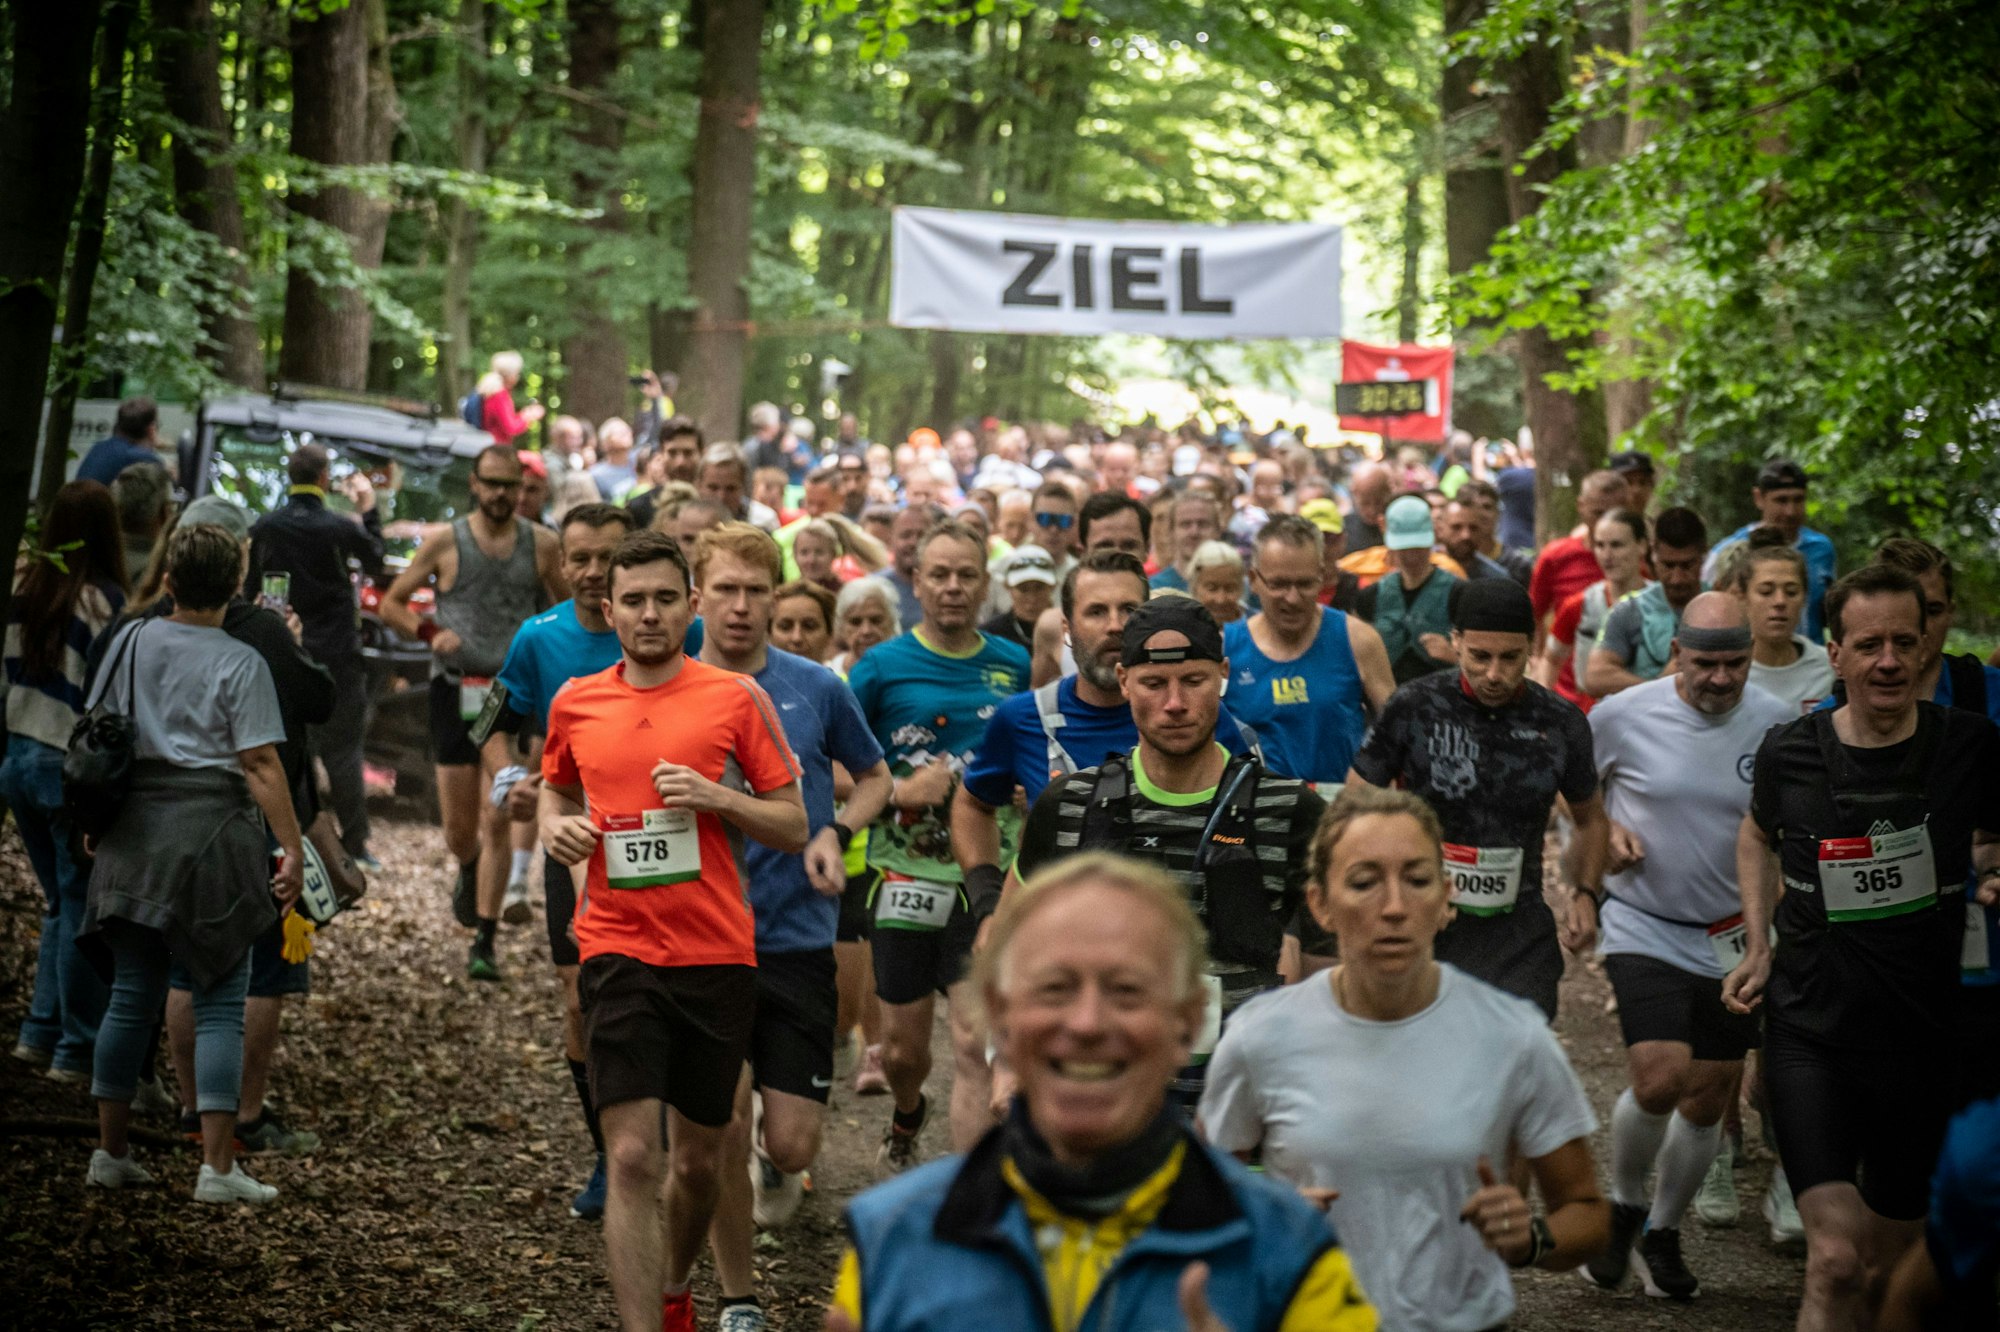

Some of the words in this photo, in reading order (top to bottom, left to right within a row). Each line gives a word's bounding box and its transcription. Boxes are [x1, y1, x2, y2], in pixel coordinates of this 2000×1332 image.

[1003, 239, 1233, 312] ZIEL
[625, 839, 669, 863] 578
[1455, 872, 1507, 895] 0095
[1853, 866, 1903, 894] 365
[891, 889, 935, 913] 1234
